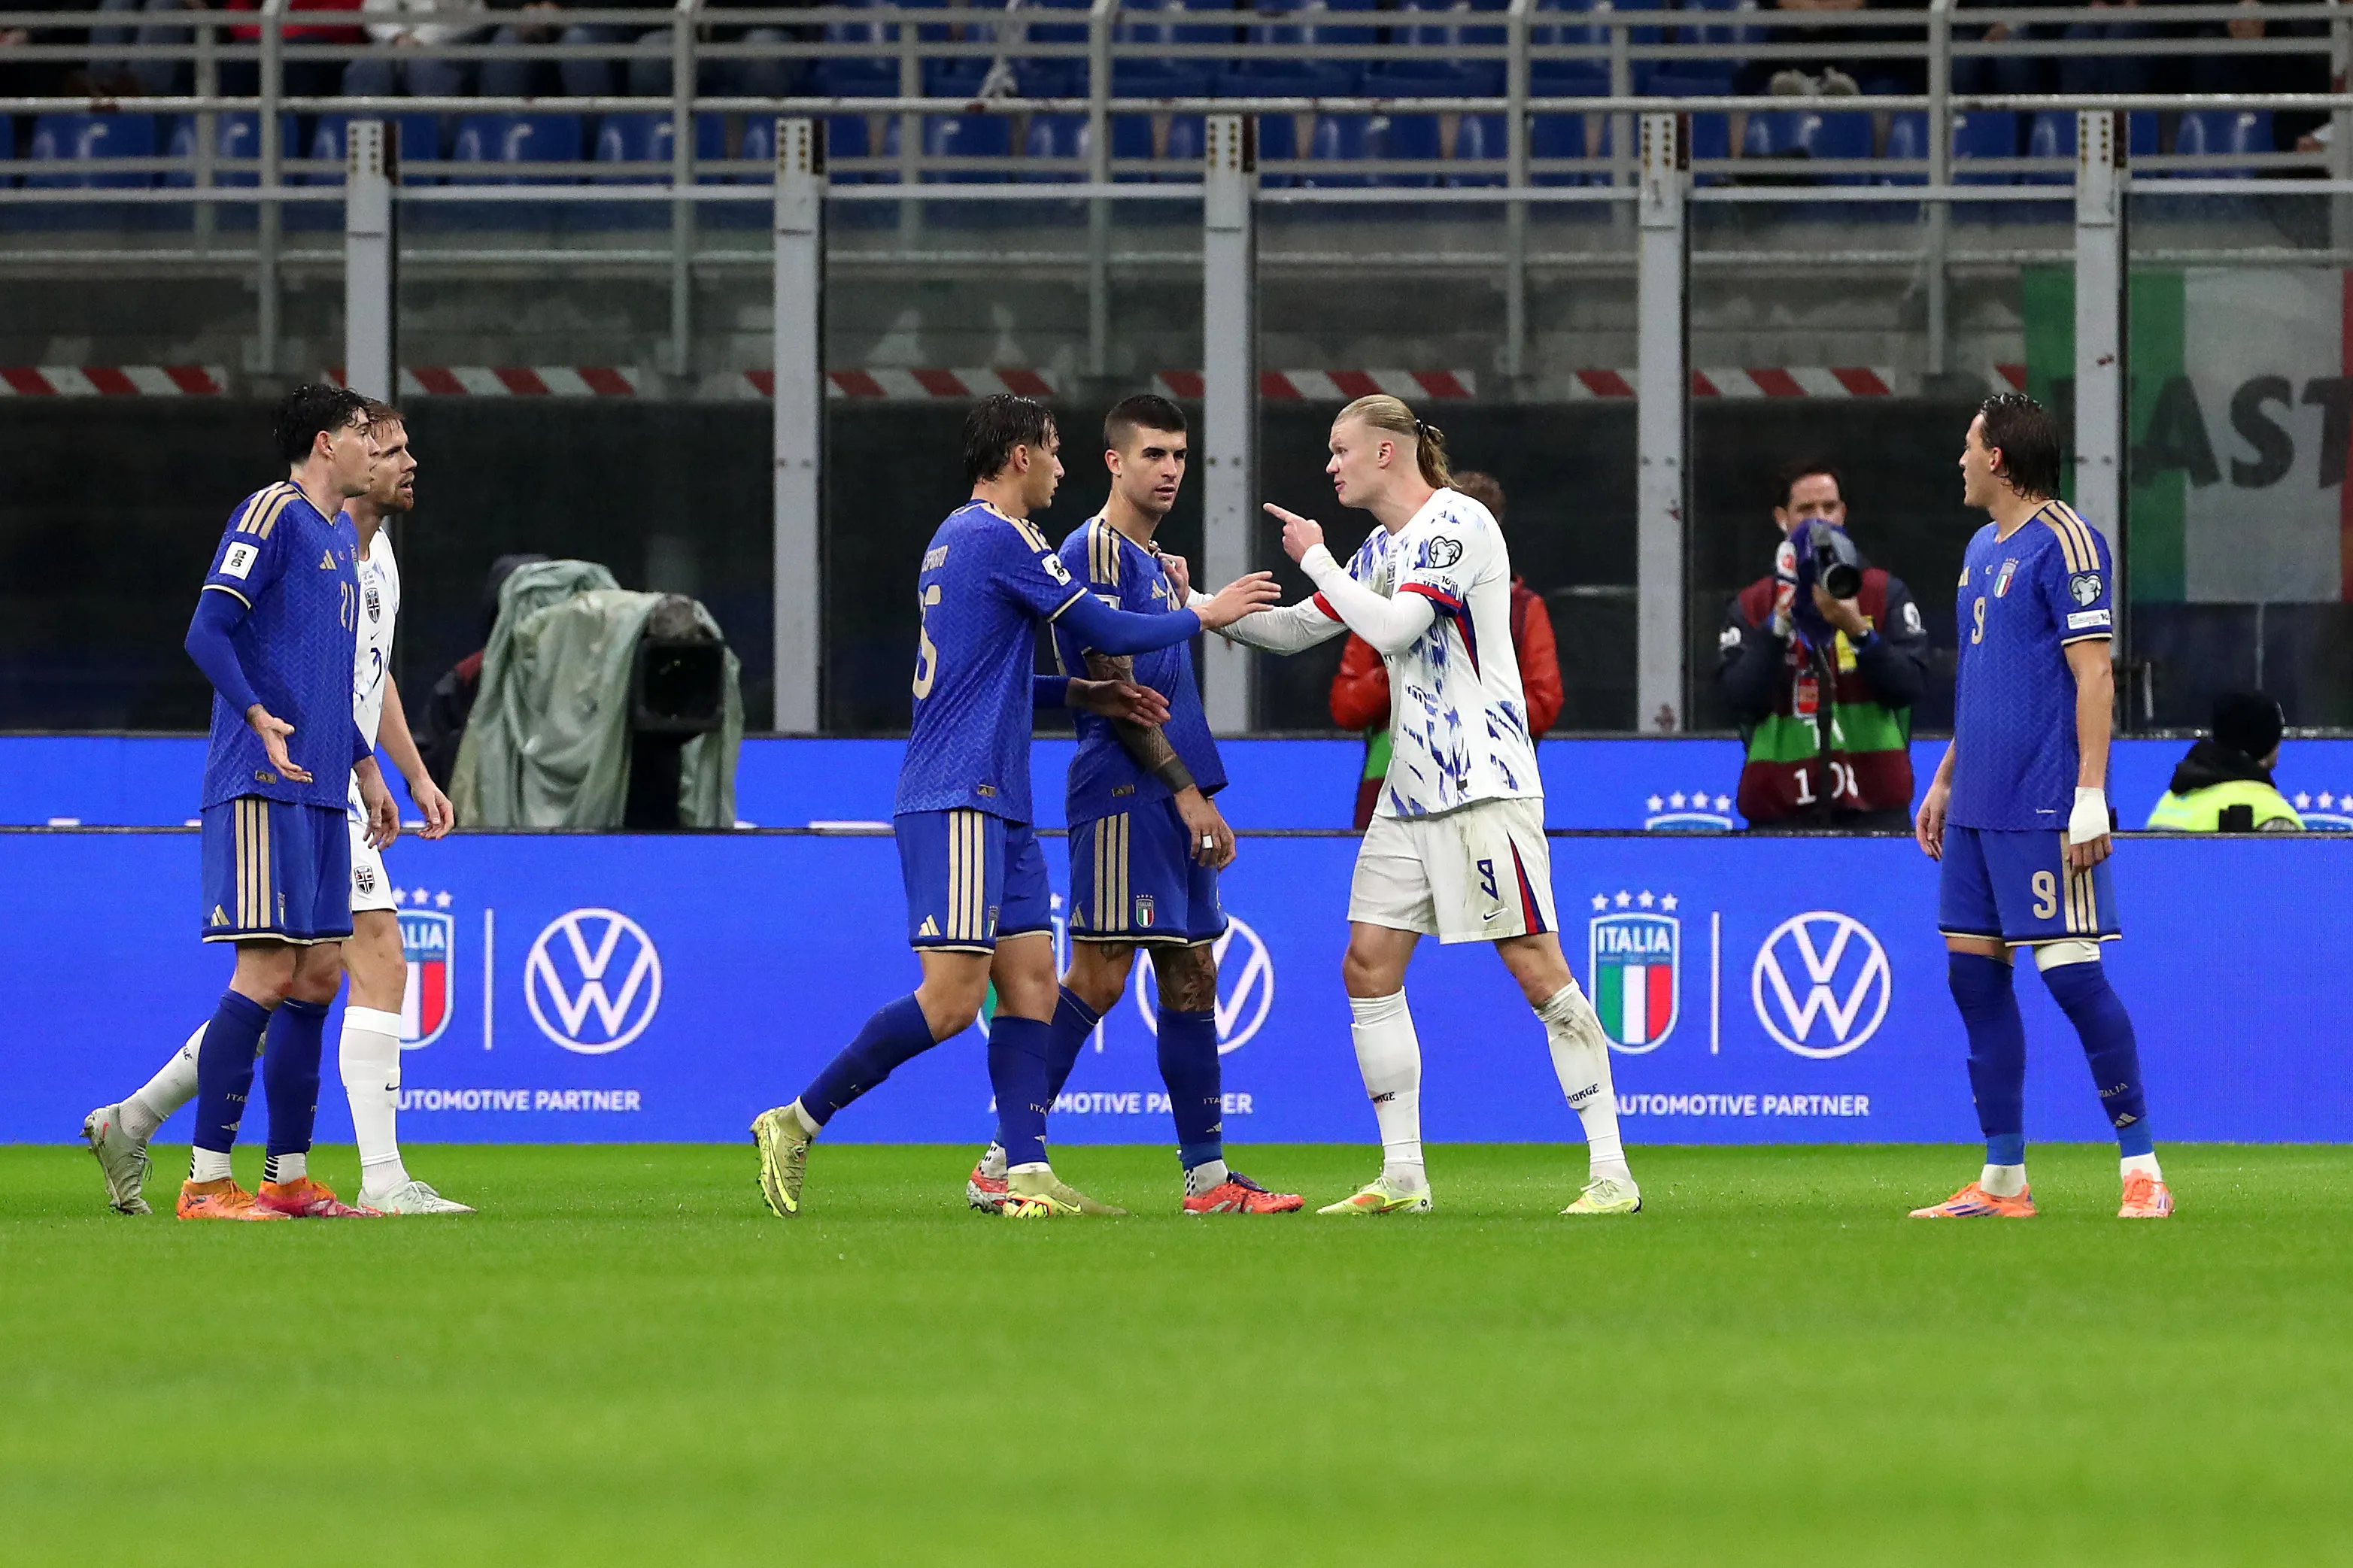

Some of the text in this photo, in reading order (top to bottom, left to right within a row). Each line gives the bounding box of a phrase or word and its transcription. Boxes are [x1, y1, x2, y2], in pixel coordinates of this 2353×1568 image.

[341, 581, 355, 632] 21
[1971, 596, 1986, 645] 9
[1477, 859, 1499, 901] 9
[2032, 870, 2057, 920] 9
[399, 923, 446, 950] LIA
[1597, 925, 1671, 953] ITALIA
[396, 1090, 642, 1112] UTOMOTIVE PARTNER
[1146, 1092, 1253, 1115] PAER
[1762, 1093, 1870, 1117] PARTNER
